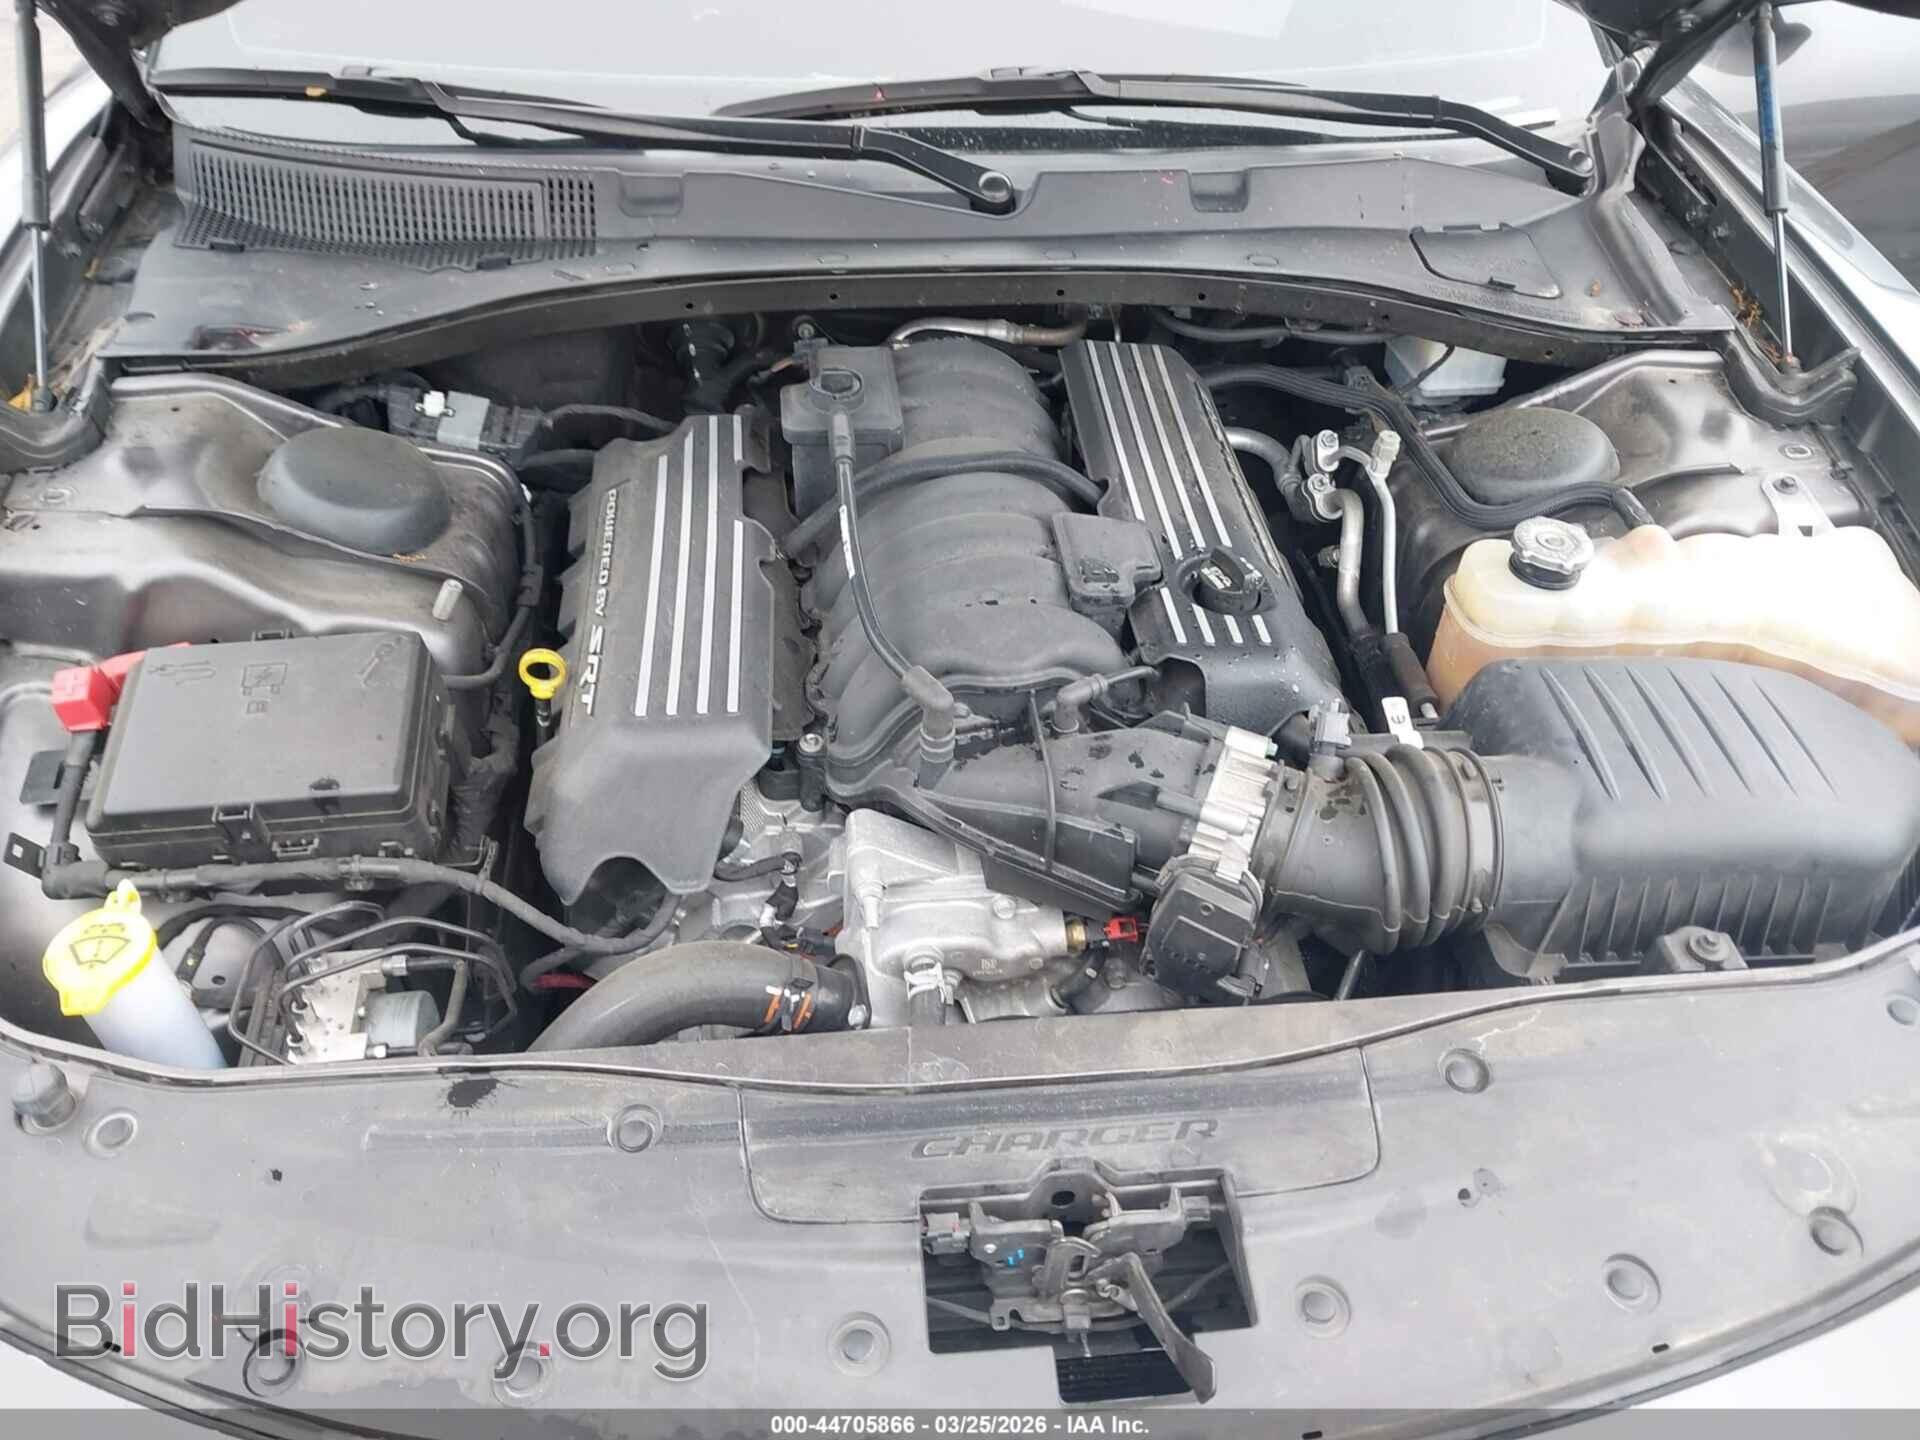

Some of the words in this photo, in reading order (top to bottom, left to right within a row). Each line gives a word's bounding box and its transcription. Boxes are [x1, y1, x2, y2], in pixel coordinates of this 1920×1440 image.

[599, 488, 617, 584] POWERED
[579, 624, 604, 716] SRT
[911, 1119, 1218, 1159] CHARGER
